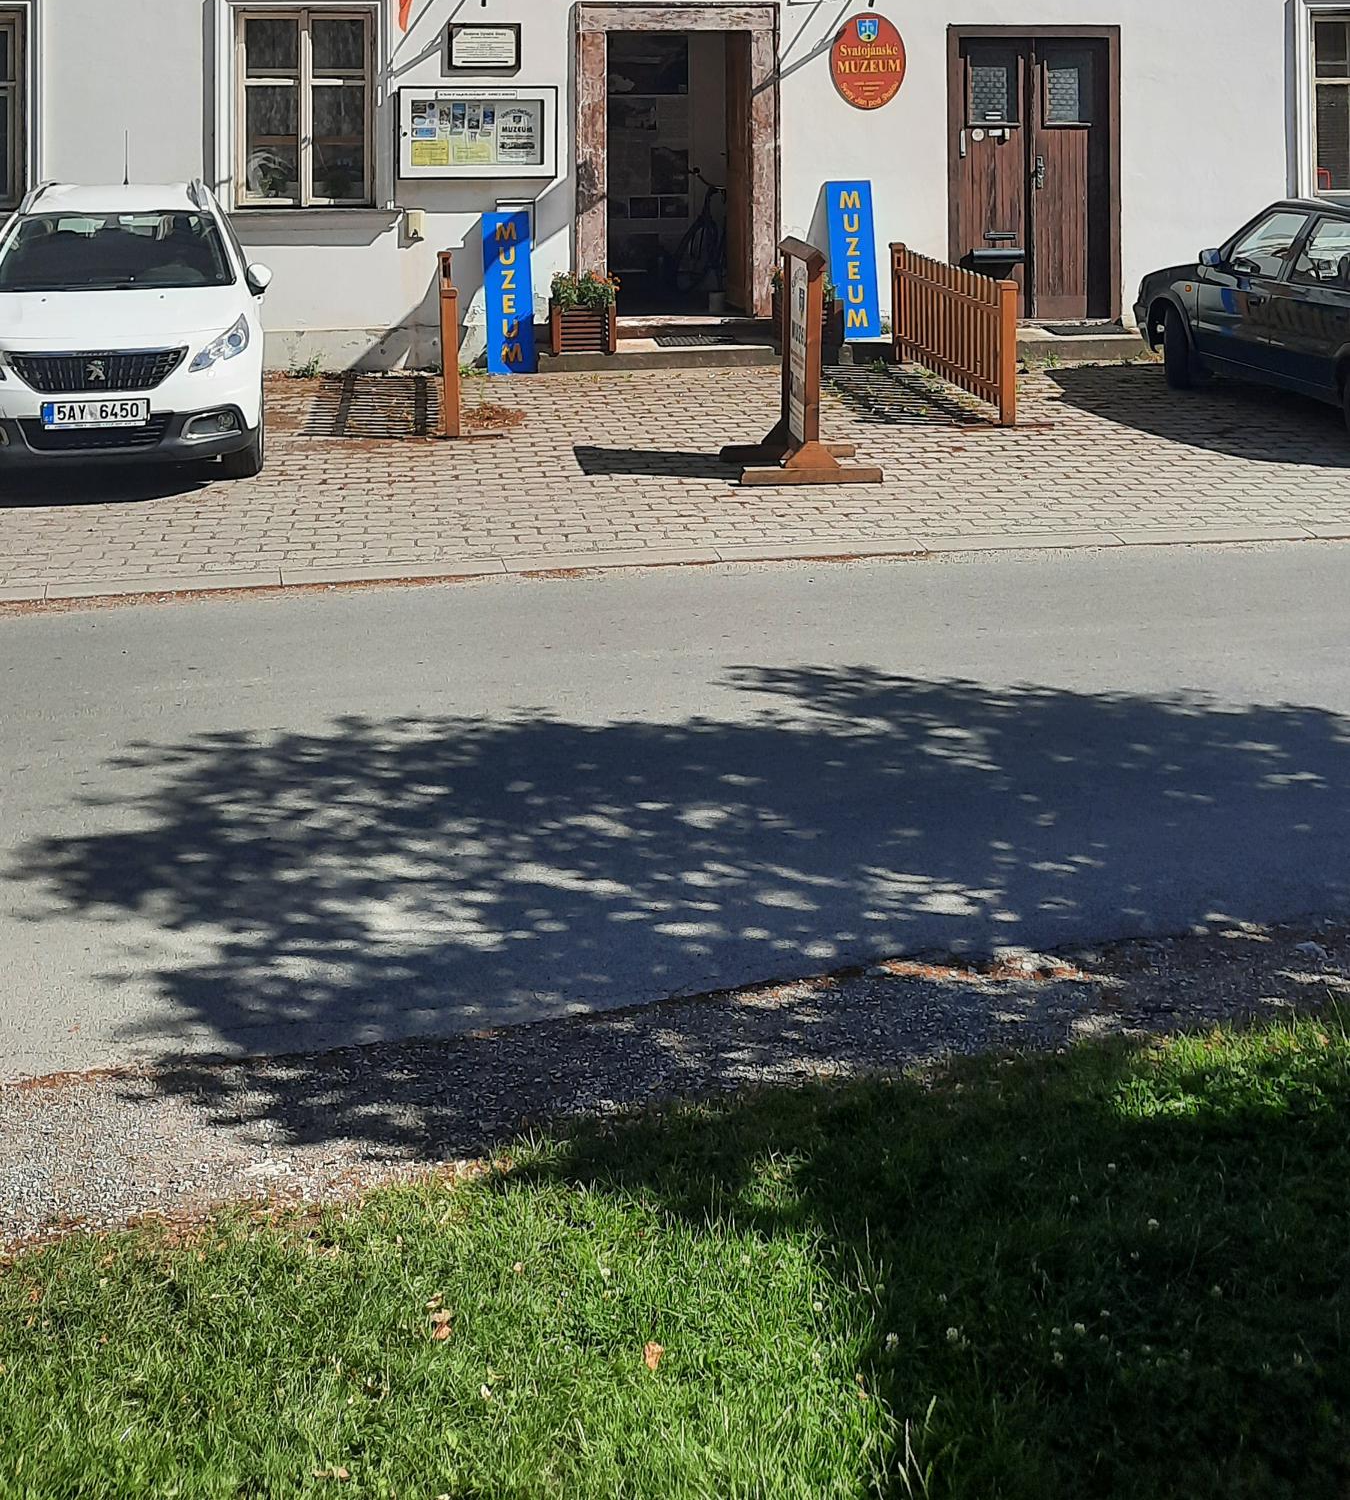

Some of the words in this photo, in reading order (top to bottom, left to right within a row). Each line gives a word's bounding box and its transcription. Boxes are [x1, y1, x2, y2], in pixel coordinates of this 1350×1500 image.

[839, 43, 898, 58] Svatojánské
[837, 59, 901, 73] MUZEUM
[839, 190, 868, 328] MUZEUM
[495, 222, 523, 363] MUZEUM
[57, 404, 86, 421] 5AY
[99, 402, 139, 419] 6450
